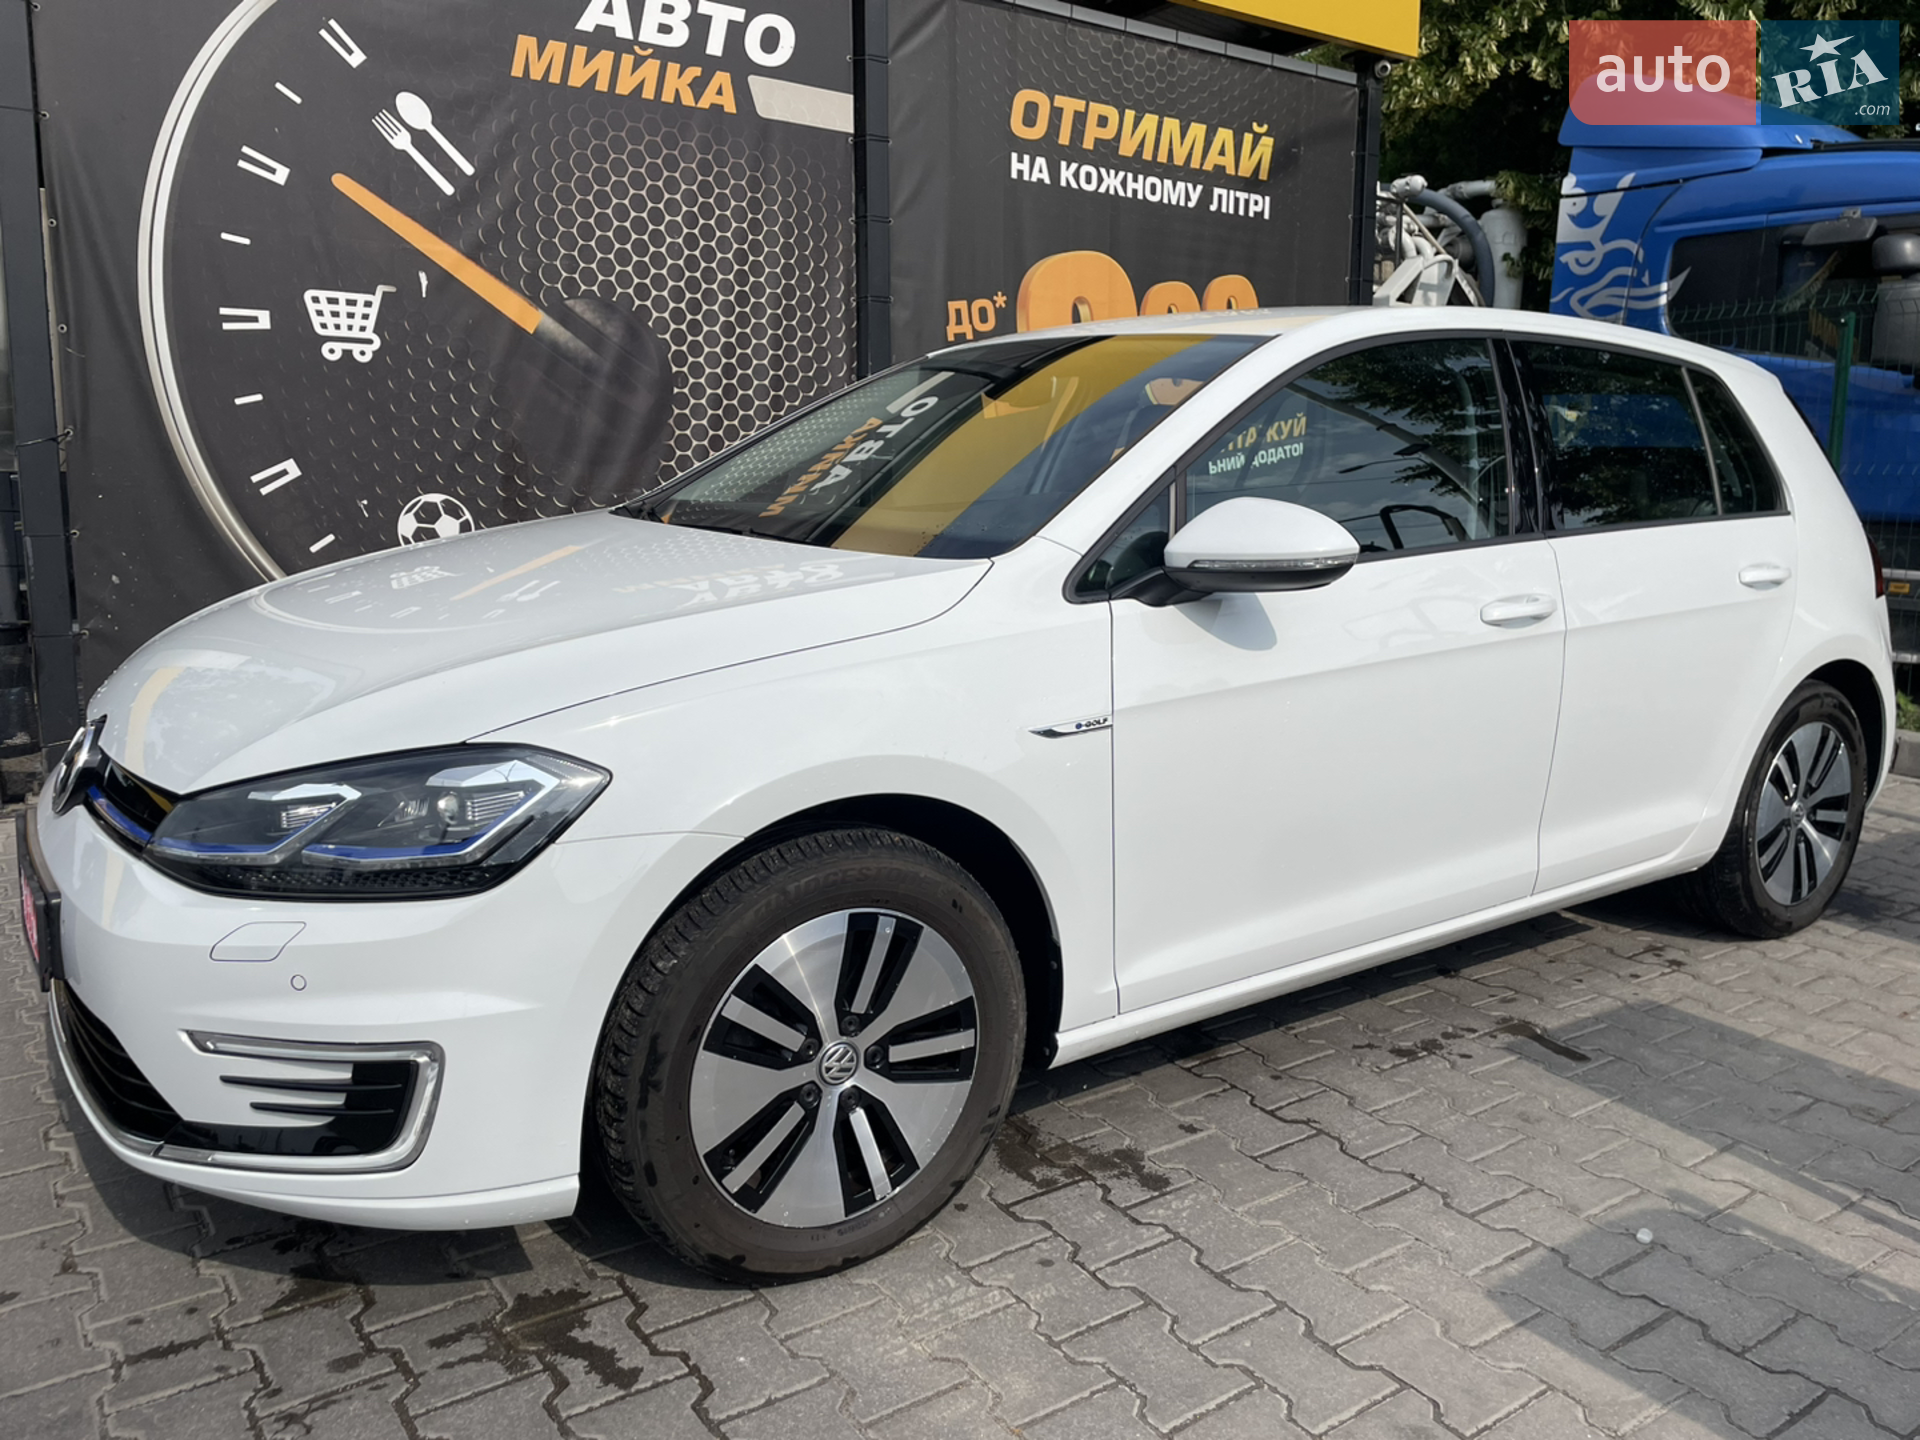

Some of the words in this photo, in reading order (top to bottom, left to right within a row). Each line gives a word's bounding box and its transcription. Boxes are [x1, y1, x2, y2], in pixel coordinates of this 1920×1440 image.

[575, 0, 796, 67] АВТО
[510, 34, 737, 114] МИЙКА
[1010, 89, 1275, 181] ОТРИМАЙ
[1010, 152, 1051, 185] НА
[1059, 160, 1203, 209] КОЖНОМУ
[1209, 187, 1271, 220] ЛІТРІ
